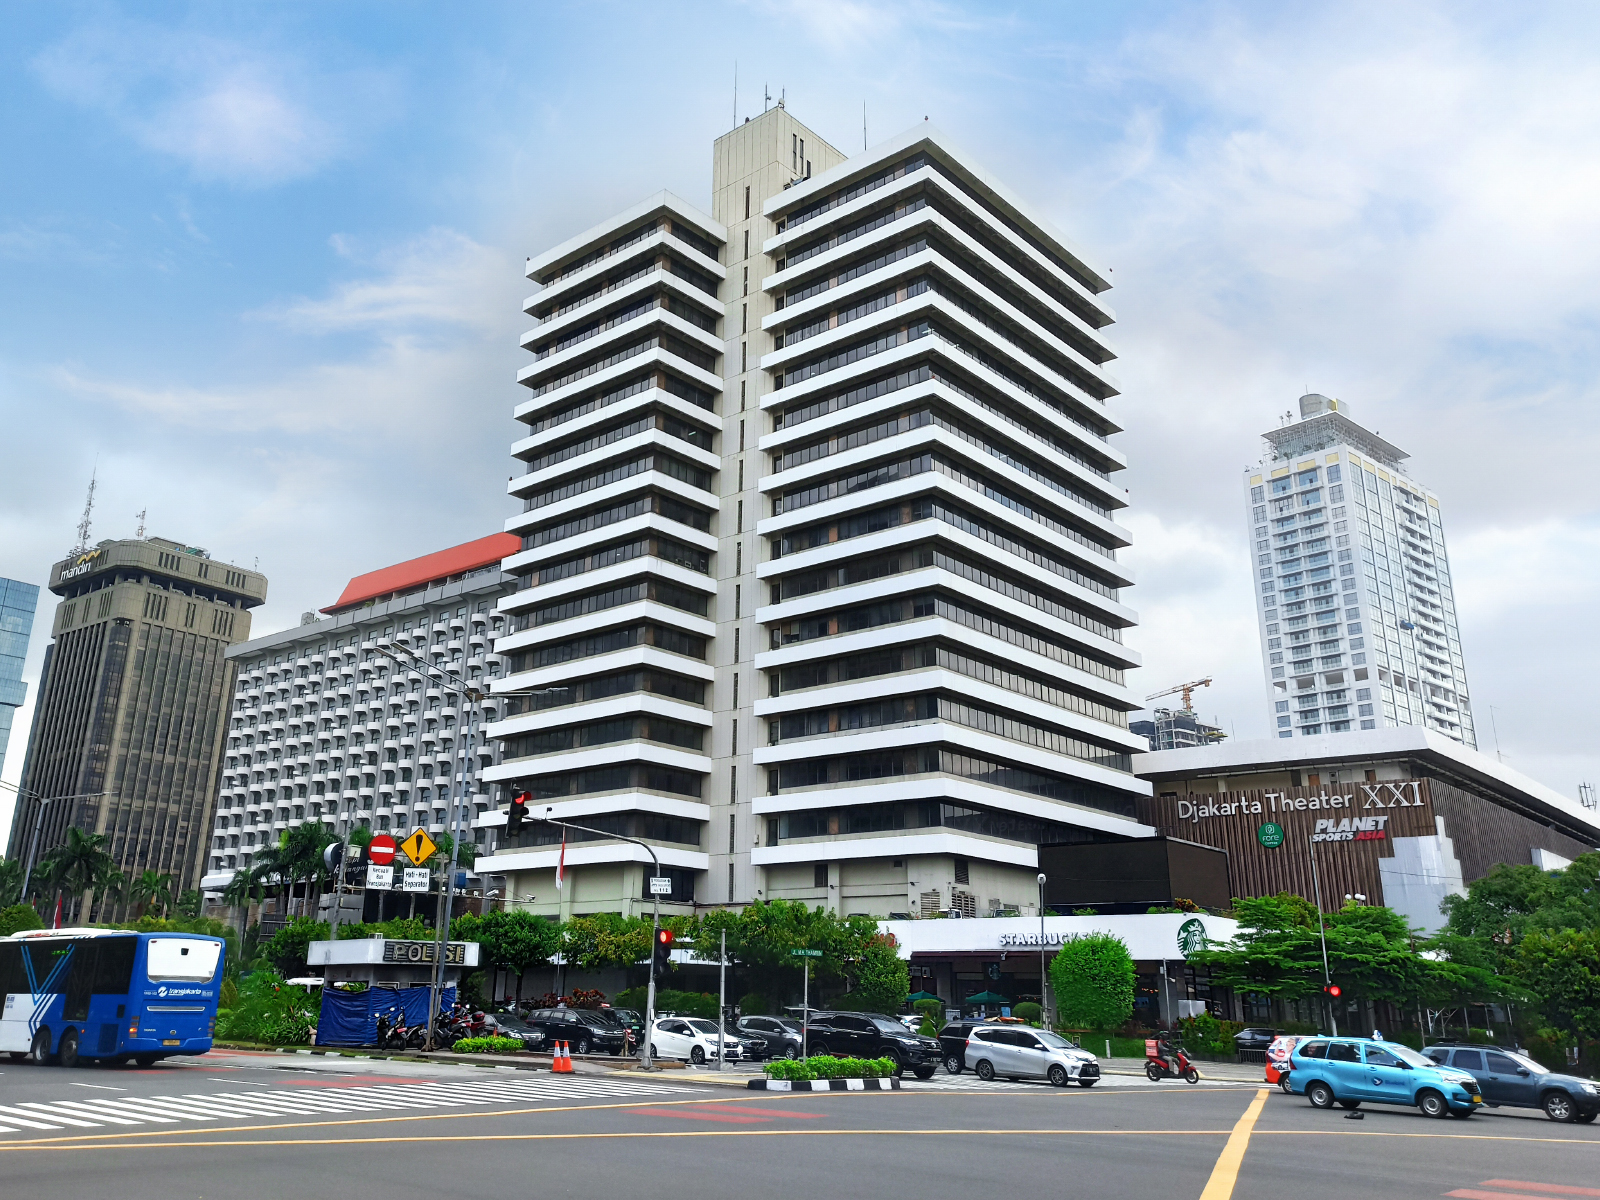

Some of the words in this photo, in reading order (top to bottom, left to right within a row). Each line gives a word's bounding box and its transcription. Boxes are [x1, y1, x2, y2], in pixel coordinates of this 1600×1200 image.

[1178, 796, 1263, 823] Djakarta
[1265, 790, 1353, 814] Theater
[1360, 781, 1425, 809] XXI
[1315, 815, 1388, 833] PLANET
[404, 880, 428, 889] Separator
[393, 943, 462, 962] POLSI
